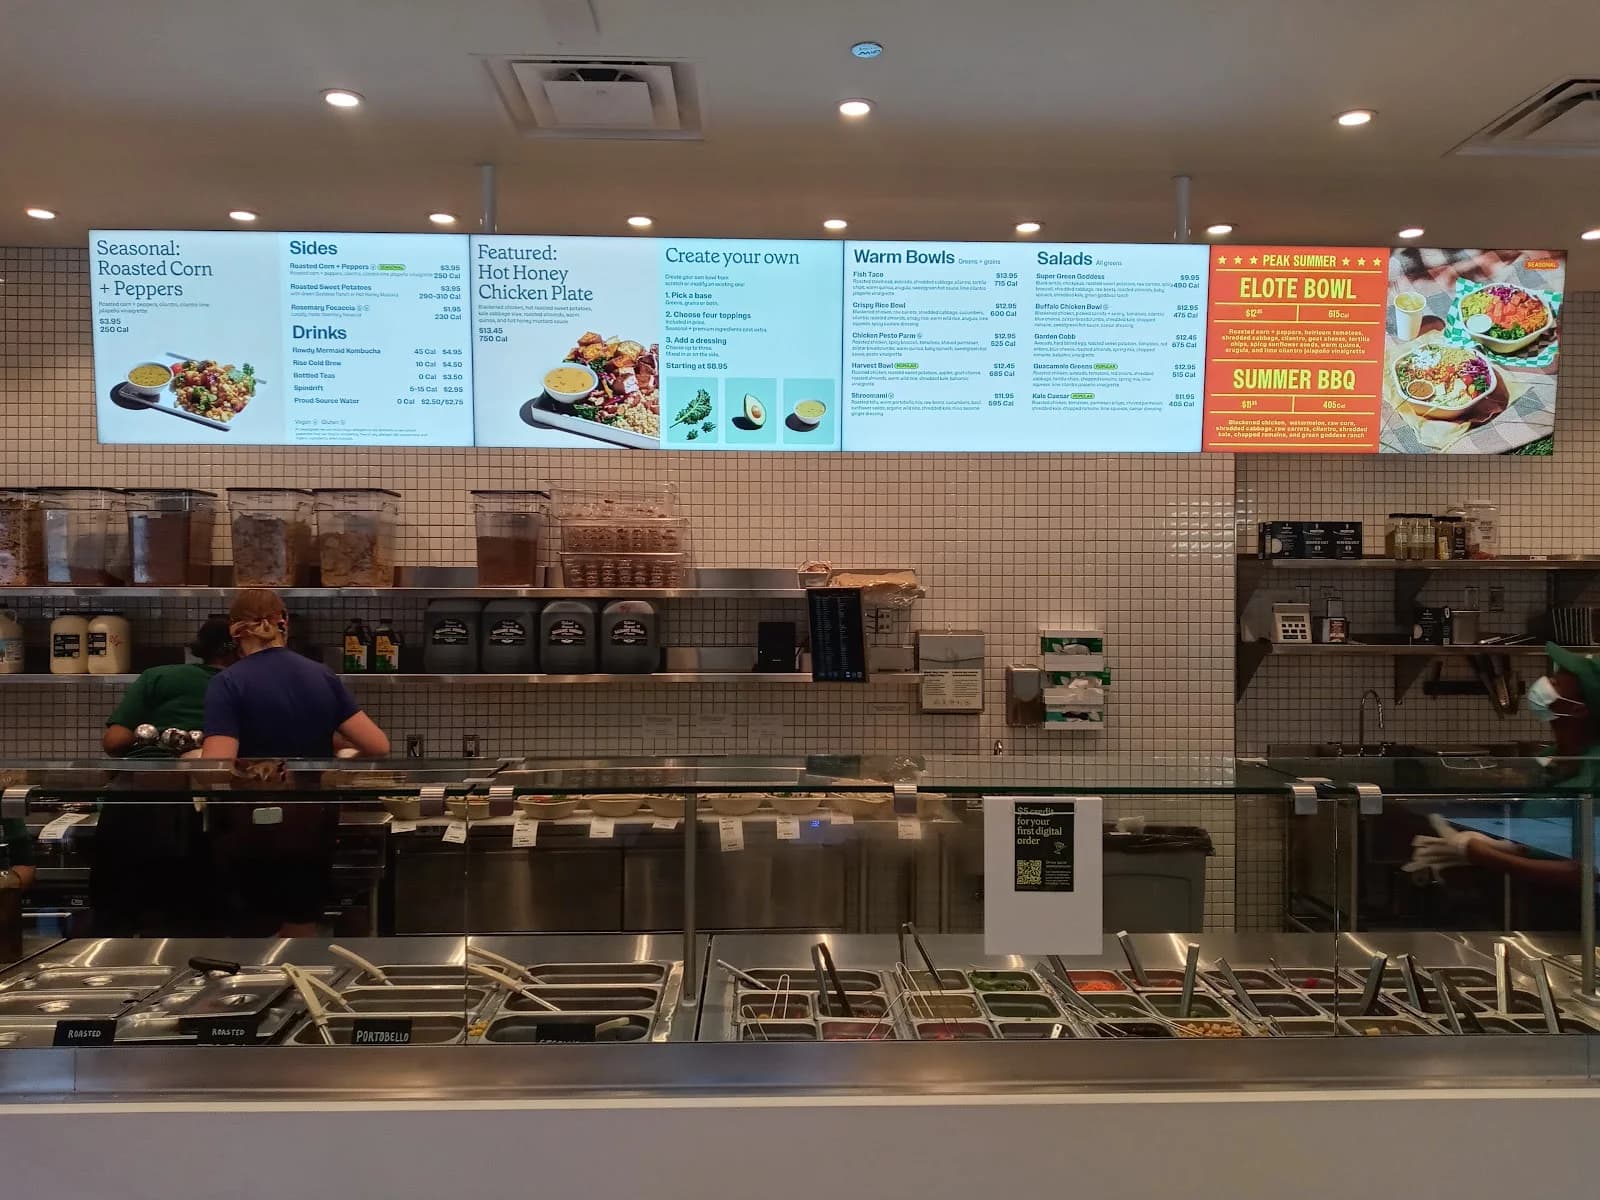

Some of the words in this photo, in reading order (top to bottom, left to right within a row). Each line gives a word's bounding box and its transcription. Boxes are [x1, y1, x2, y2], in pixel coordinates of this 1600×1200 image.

[97, 240, 180, 256] Seasonal:
[289, 240, 338, 255] Sides
[478, 244, 557, 260] Featured:
[665, 247, 720, 263] Create
[723, 252, 761, 267] your
[764, 252, 800, 265] own
[853, 249, 903, 264] Warm
[906, 250, 955, 264] Bowls
[1037, 251, 1093, 266] Salads
[1263, 255, 1290, 267] PEAK
[1293, 255, 1336, 267] SUMMER
[98, 260, 167, 276] Roasted
[170, 261, 213, 276] Corn
[478, 264, 509, 280] Hot
[513, 265, 568, 284] Honey
[100, 284, 110, 293] +
[114, 281, 183, 299] Peppers
[479, 284, 547, 300] Chicken
[551, 285, 594, 301] Plate
[1240, 277, 1298, 299] ELOTE
[1304, 278, 1357, 299] BOWL
[671, 291, 688, 299] Pick
[291, 304, 325, 312] Rosemary
[852, 302, 875, 310] Crispy
[702, 311, 718, 319] four
[719, 312, 752, 320] toppings
[292, 325, 347, 340] Drinks
[665, 336, 673, 344] 3.
[695, 337, 727, 346] dressing
[665, 362, 697, 371] Starting
[1233, 368, 1311, 389] SUMMER
[1318, 369, 1356, 390] BBQ
[294, 384, 324, 392] Spindrift
[1017, 816, 1029, 826] for
[1029, 819, 1050, 828] your
[1017, 826, 1035, 835] first
[1035, 826, 1062, 838] digital
[1017, 836, 1041, 845] order
[68, 1028, 101, 1039] ROASTED
[211, 1028, 245, 1037] ROASTED
[356, 1030, 409, 1043] PORTOBELLO
